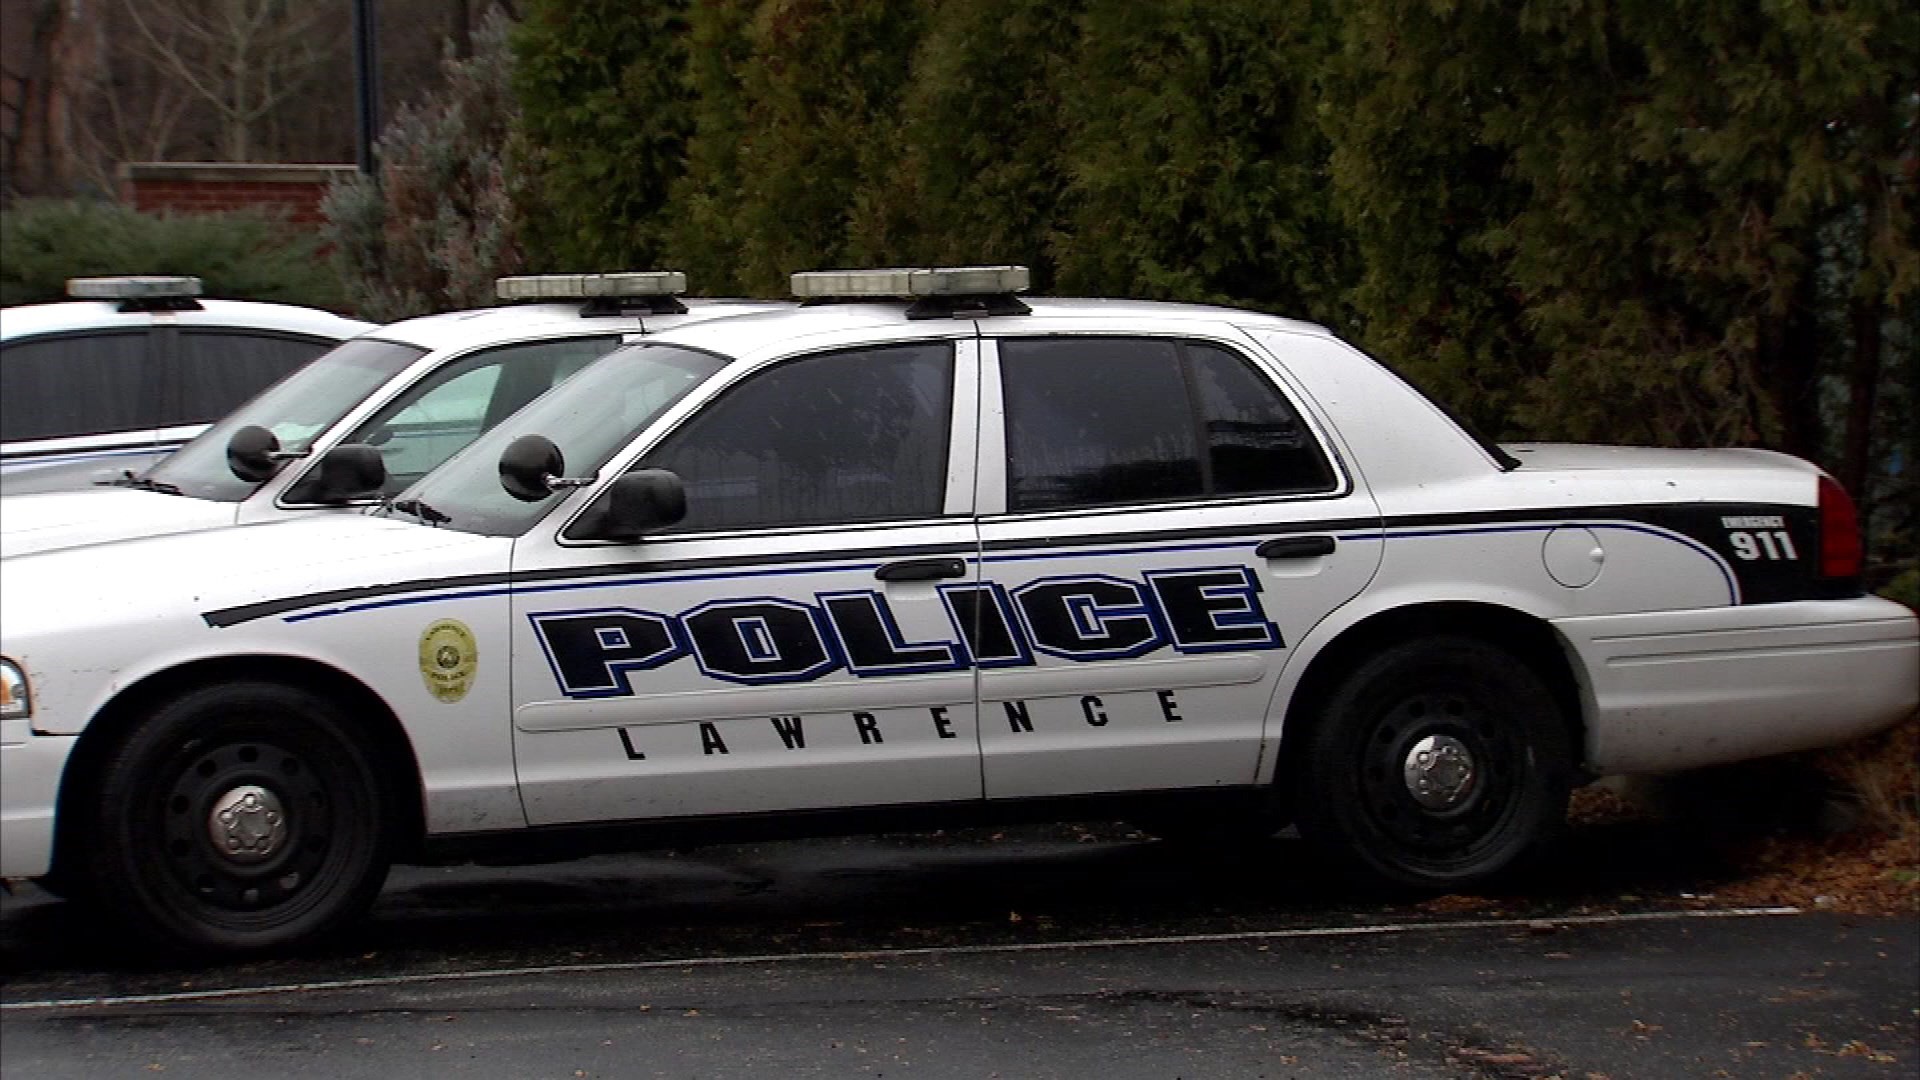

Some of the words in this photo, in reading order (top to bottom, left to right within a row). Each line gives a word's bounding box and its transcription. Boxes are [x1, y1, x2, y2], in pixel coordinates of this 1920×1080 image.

[1729, 531, 1798, 560] 911
[527, 565, 1285, 699] POLICE
[617, 689, 1182, 761] LAWRENCE
